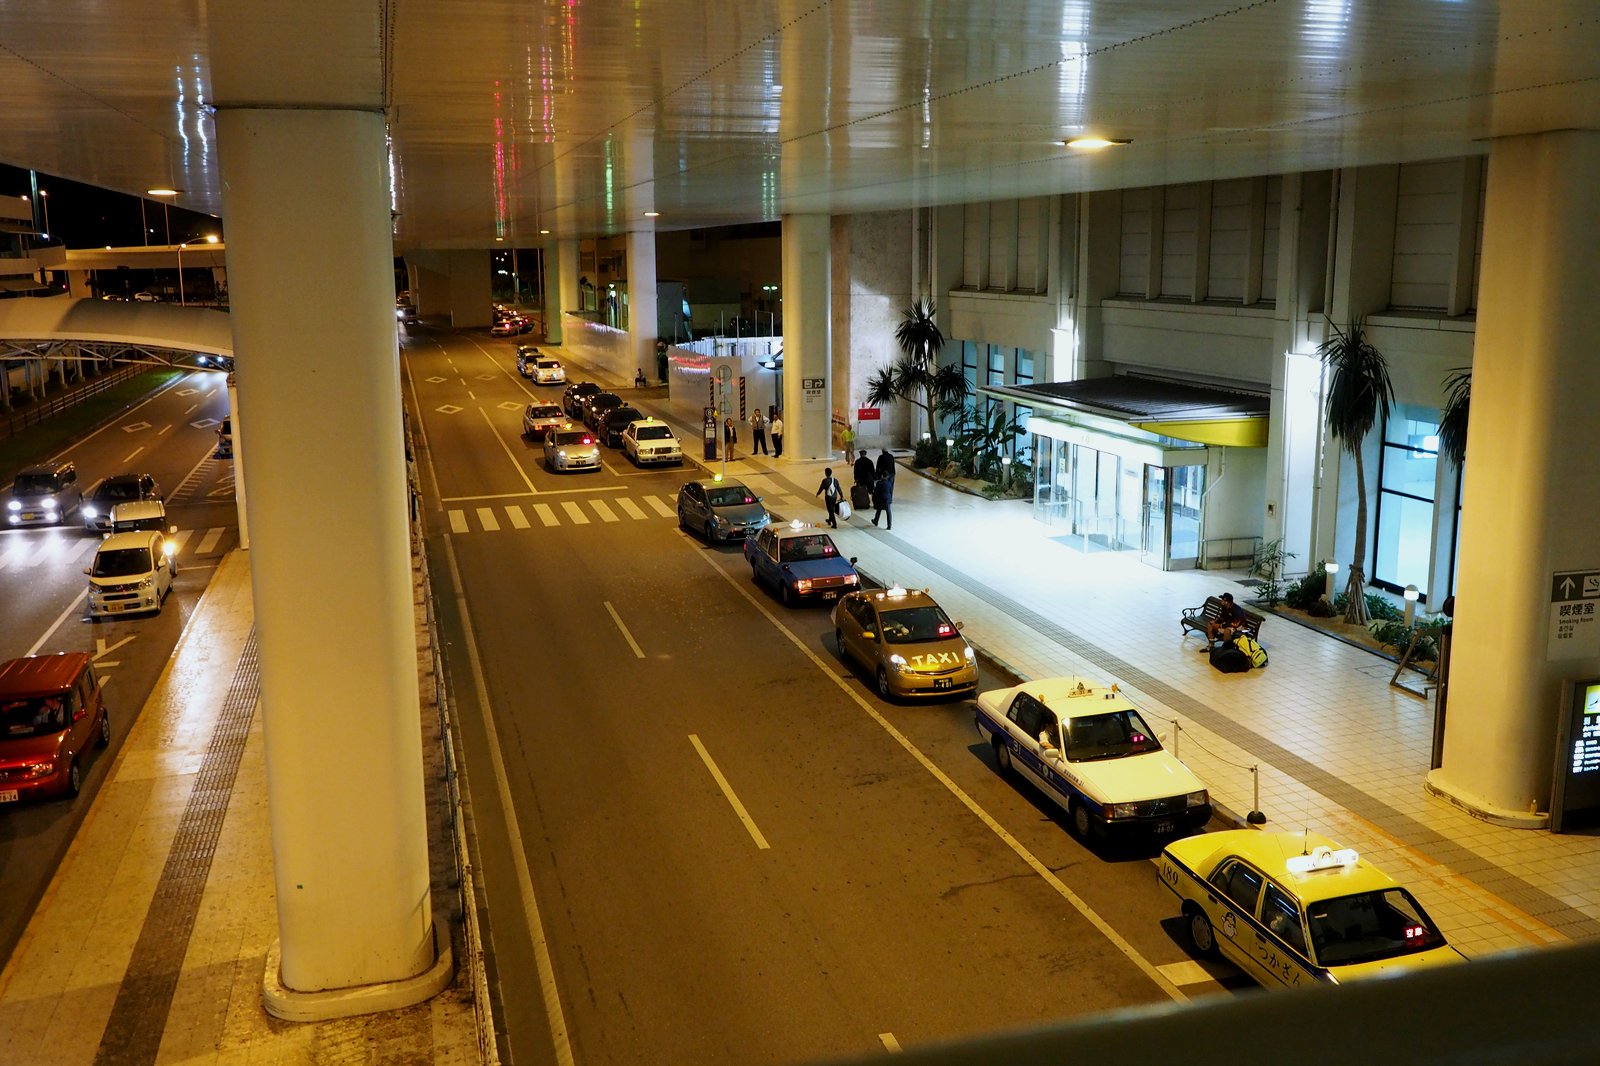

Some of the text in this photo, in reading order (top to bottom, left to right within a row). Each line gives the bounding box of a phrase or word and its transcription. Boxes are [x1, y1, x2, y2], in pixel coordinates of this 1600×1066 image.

[1560, 603, 1595, 616] 喫煙室
[912, 652, 960, 666] TAXI
[1163, 861, 1179, 886] 189
